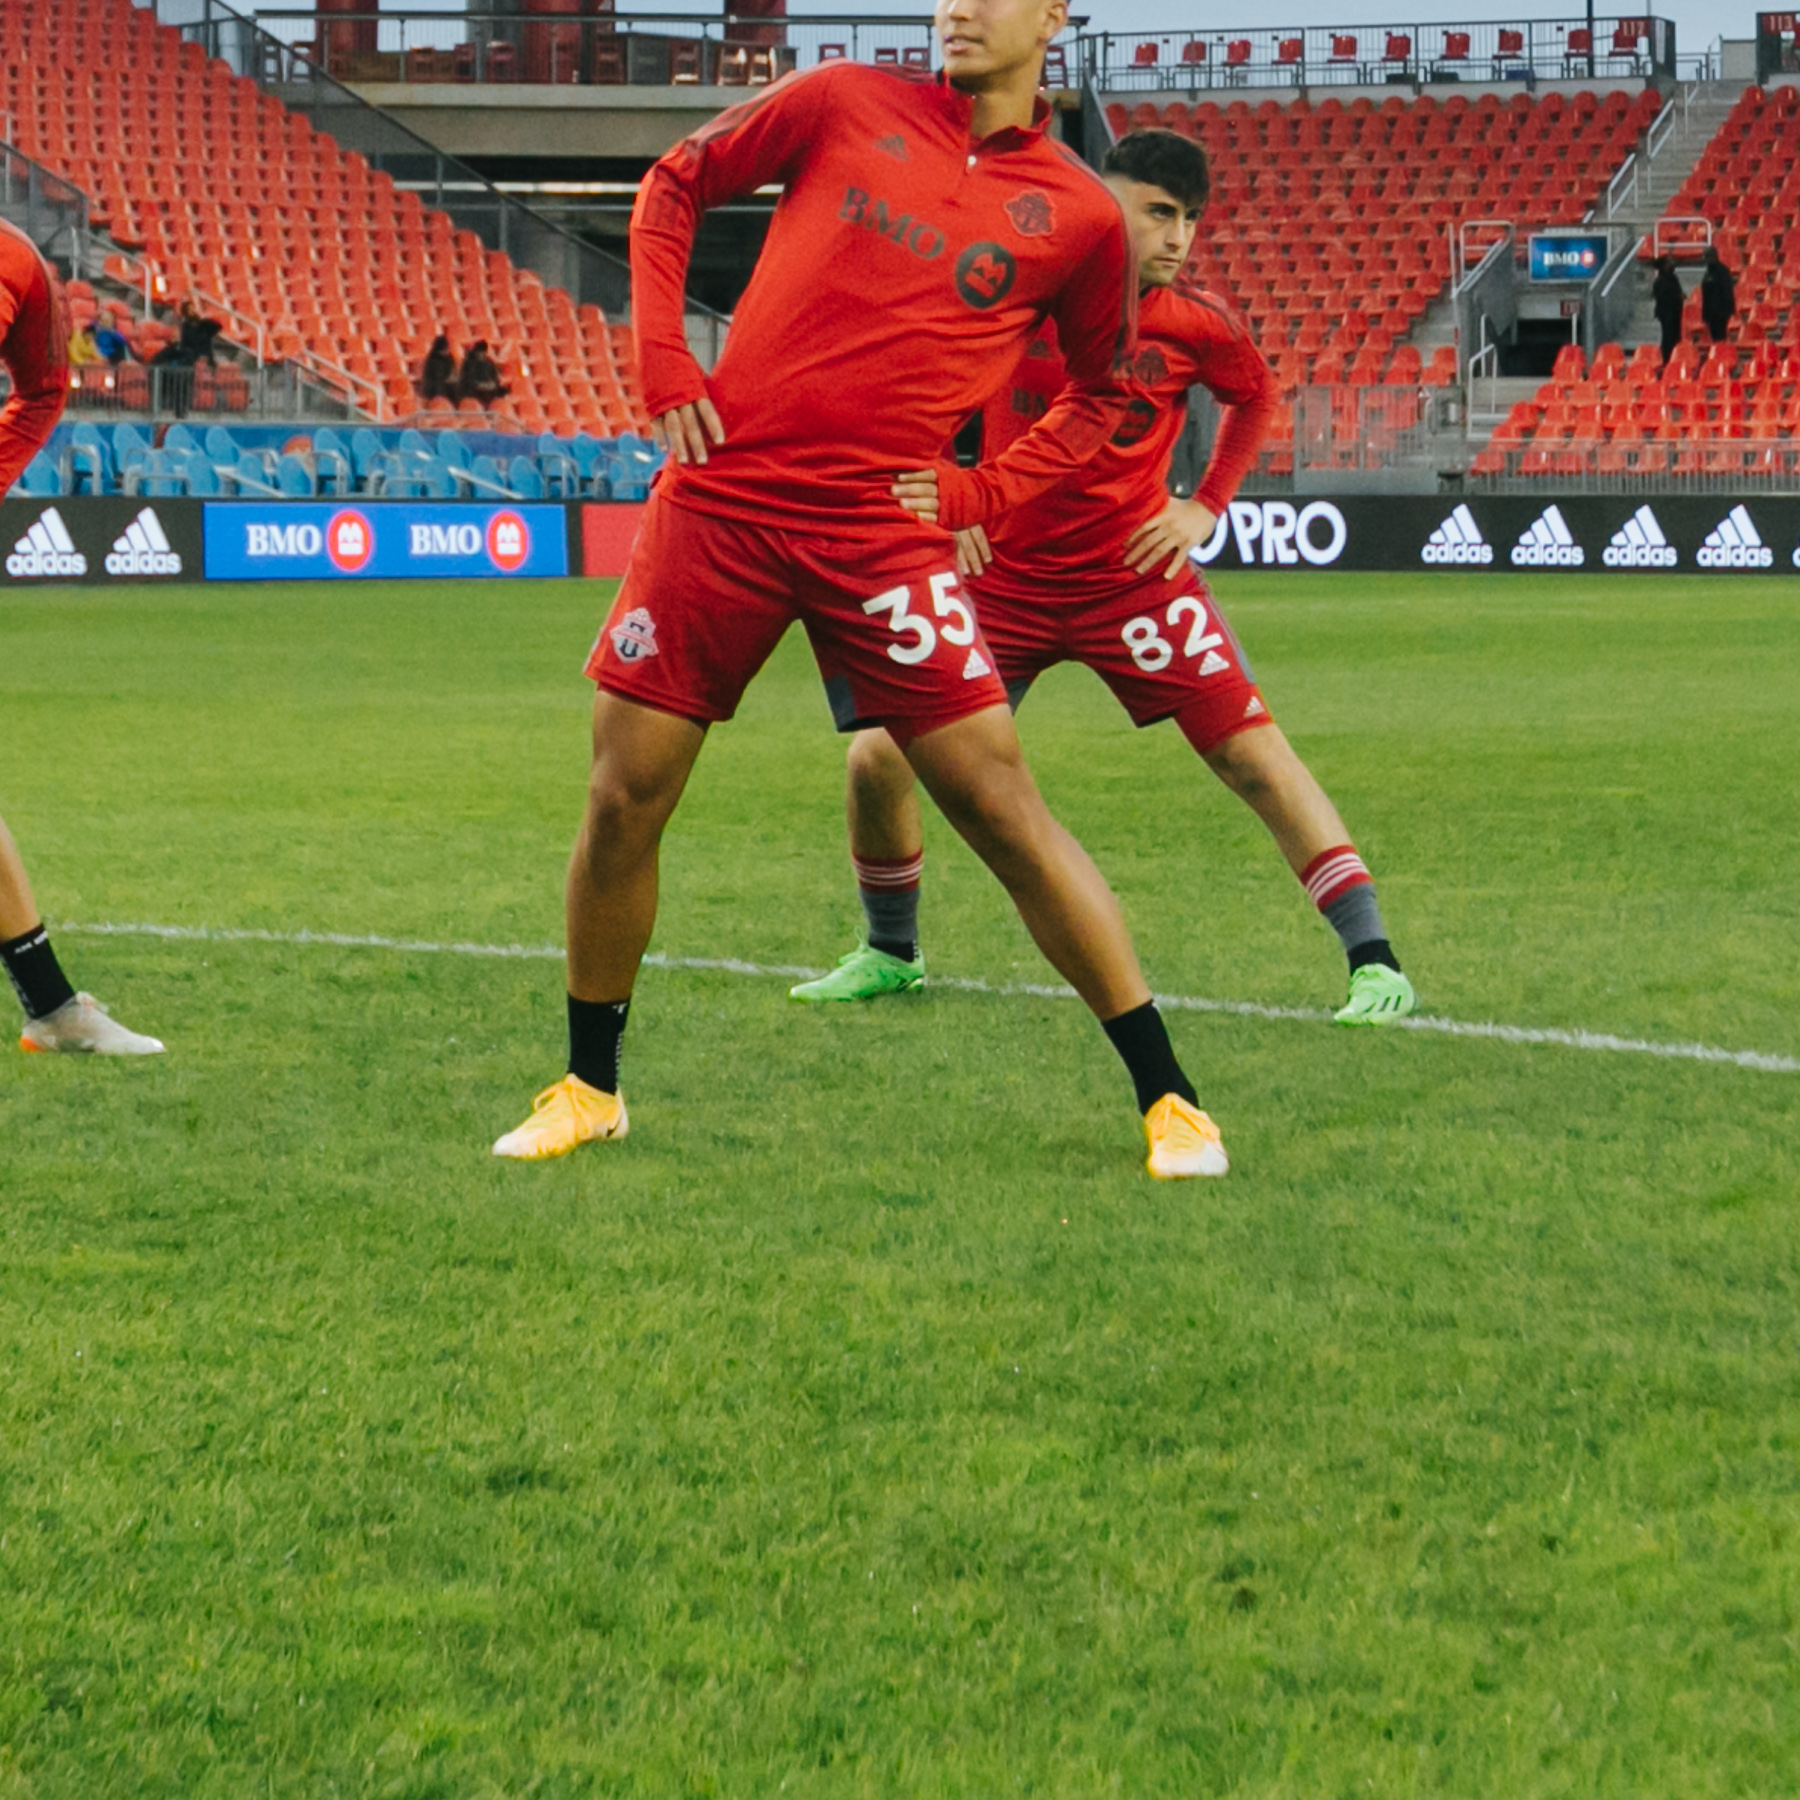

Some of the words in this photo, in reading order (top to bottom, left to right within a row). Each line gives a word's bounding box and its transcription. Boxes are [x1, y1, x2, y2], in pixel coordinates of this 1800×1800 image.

[839, 187, 944, 259] BMO
[246, 524, 322, 556] BMO
[410, 524, 482, 555] BMO
[6, 551, 87, 577] adidas
[105, 549, 182, 575] adidas
[1421, 542, 1493, 565] adidas
[1511, 543, 1584, 566] adidas
[1602, 544, 1678, 567] adidas
[1696, 544, 1773, 567] adidas
[862, 571, 974, 666] 35
[1121, 596, 1224, 672] 82
